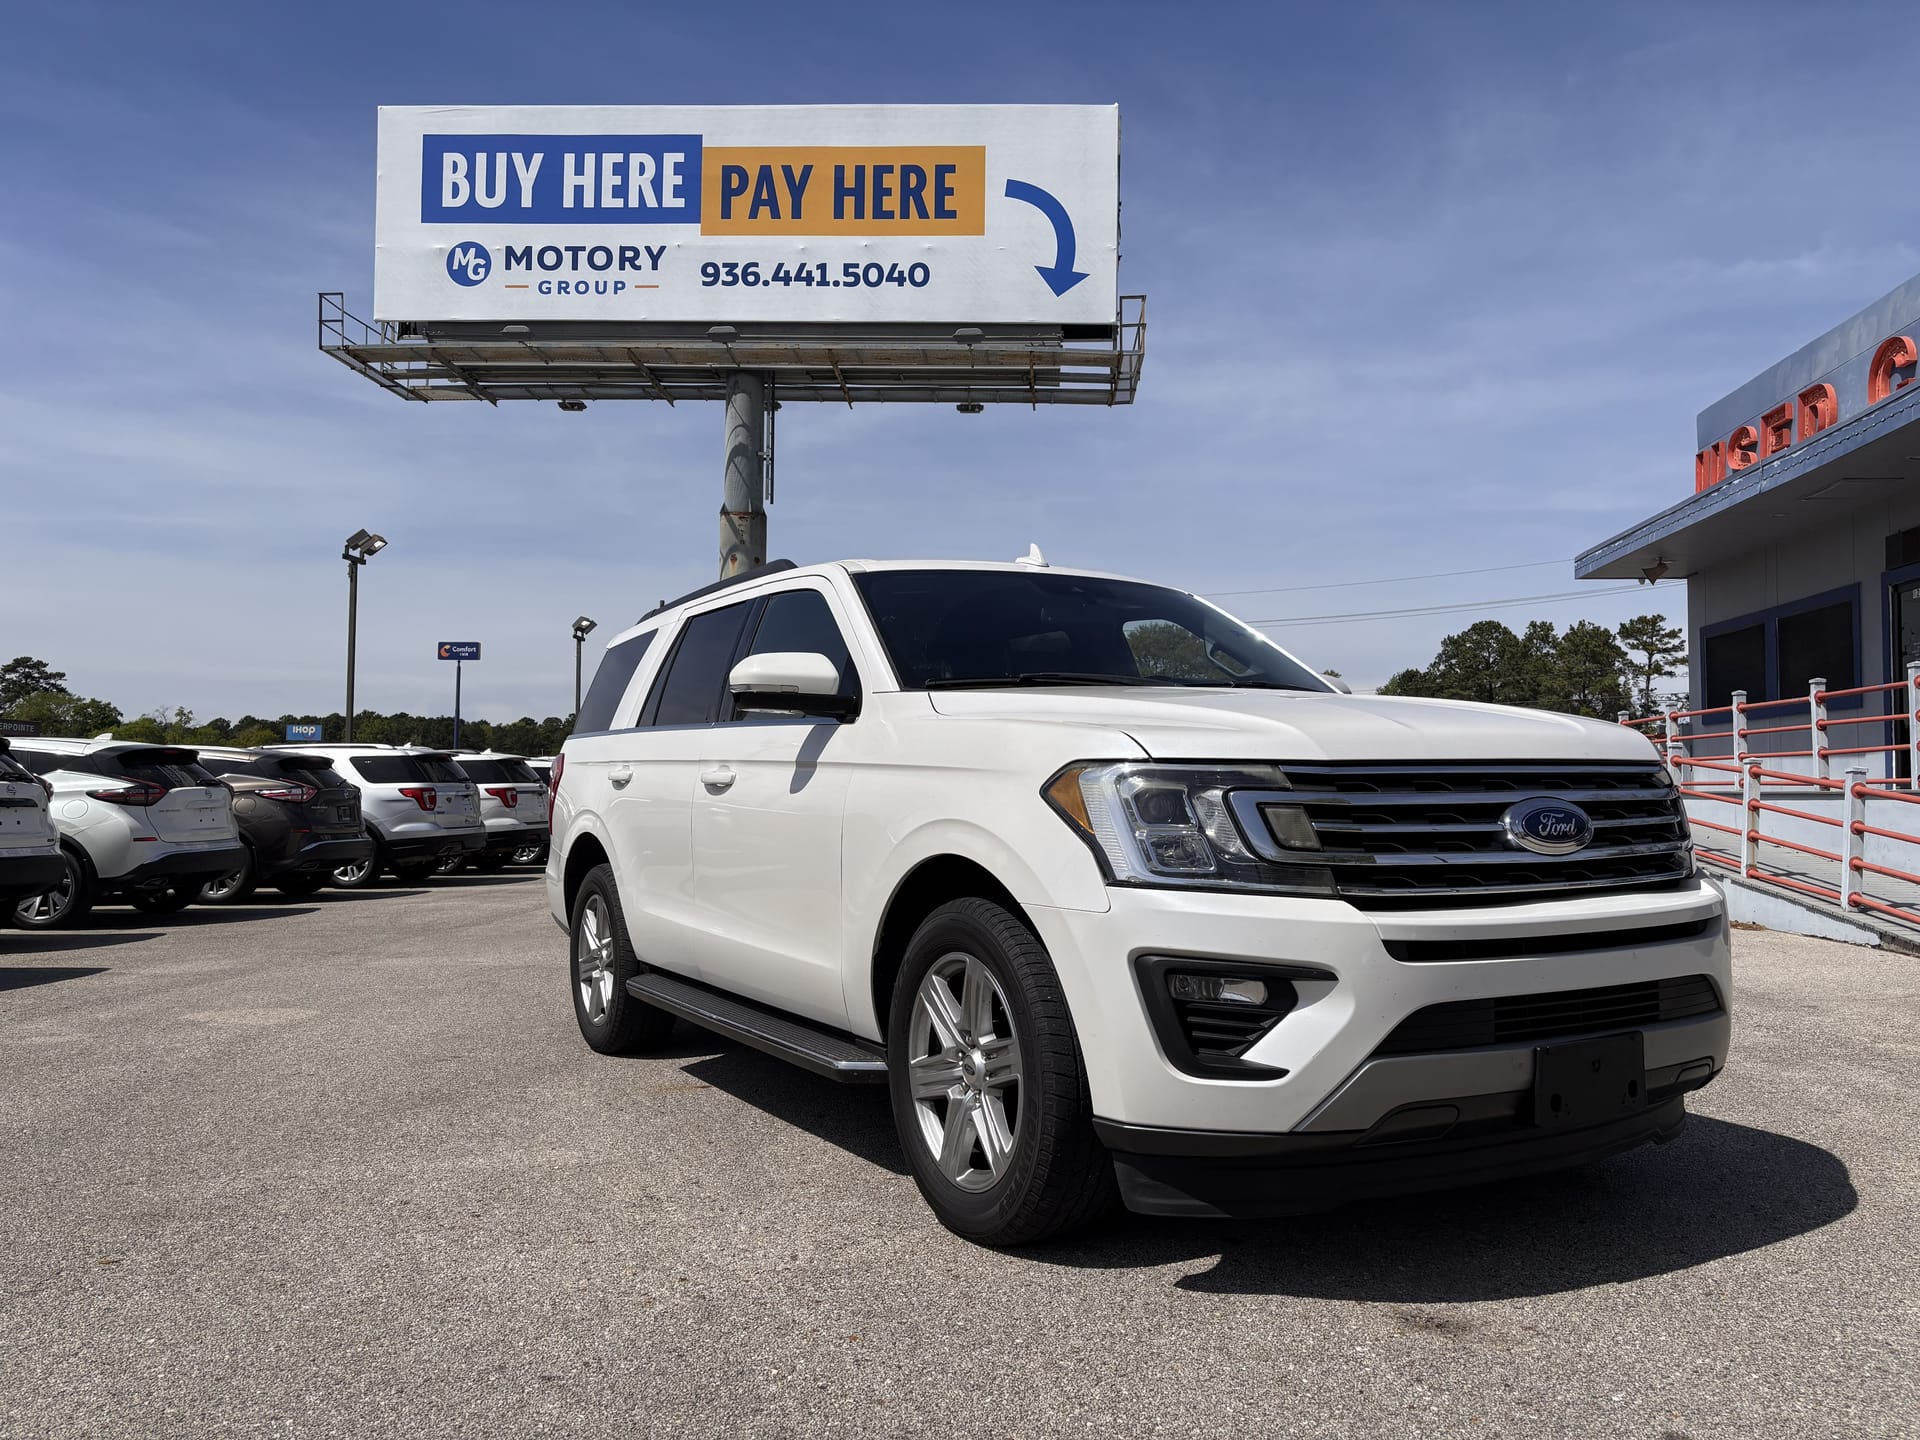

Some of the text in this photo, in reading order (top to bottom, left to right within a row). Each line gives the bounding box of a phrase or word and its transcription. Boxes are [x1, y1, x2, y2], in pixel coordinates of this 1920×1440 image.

[441, 152, 686, 209] BUY HERE
[720, 164, 958, 220] PAY HERE
[452, 247, 487, 282] MG
[504, 245, 667, 272] MOTORY
[537, 280, 627, 296] GROUP
[700, 261, 931, 288] 936.441.5040
[1538, 812, 1577, 837] Ford
